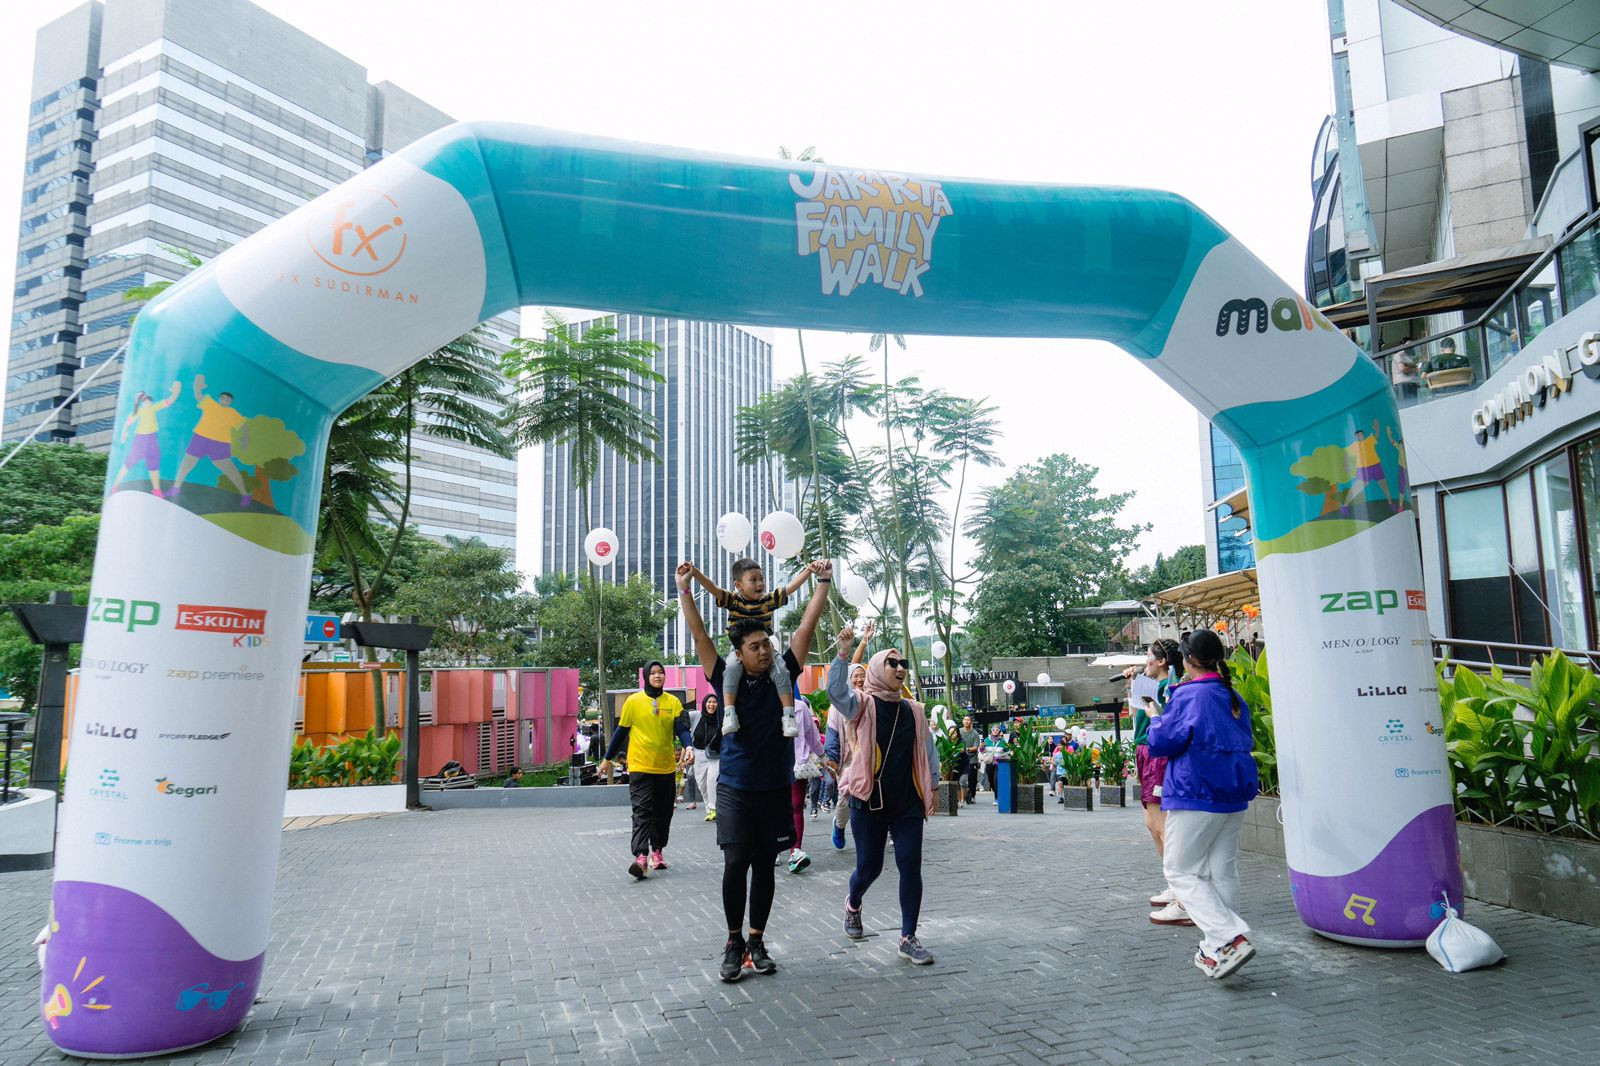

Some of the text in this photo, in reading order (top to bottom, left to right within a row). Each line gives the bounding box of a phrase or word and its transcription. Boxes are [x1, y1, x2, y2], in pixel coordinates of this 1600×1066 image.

[788, 165, 953, 216] JAKARTA
[795, 201, 941, 261] FAMILY
[818, 243, 930, 298] WALK
[314, 276, 420, 304] SUDIRMAN
[1472, 348, 1572, 436] COMMON
[90, 597, 161, 633] zap
[1320, 589, 1398, 615] zap
[178, 611, 263, 630] ESKULIN
[232, 634, 272, 648] KIDS
[1321, 636, 1400, 650] MEN/O/LOGY
[166, 668, 264, 681] zap premiere
[1378, 735, 1414, 743] CRYSTAL
[165, 783, 218, 798] Segari
